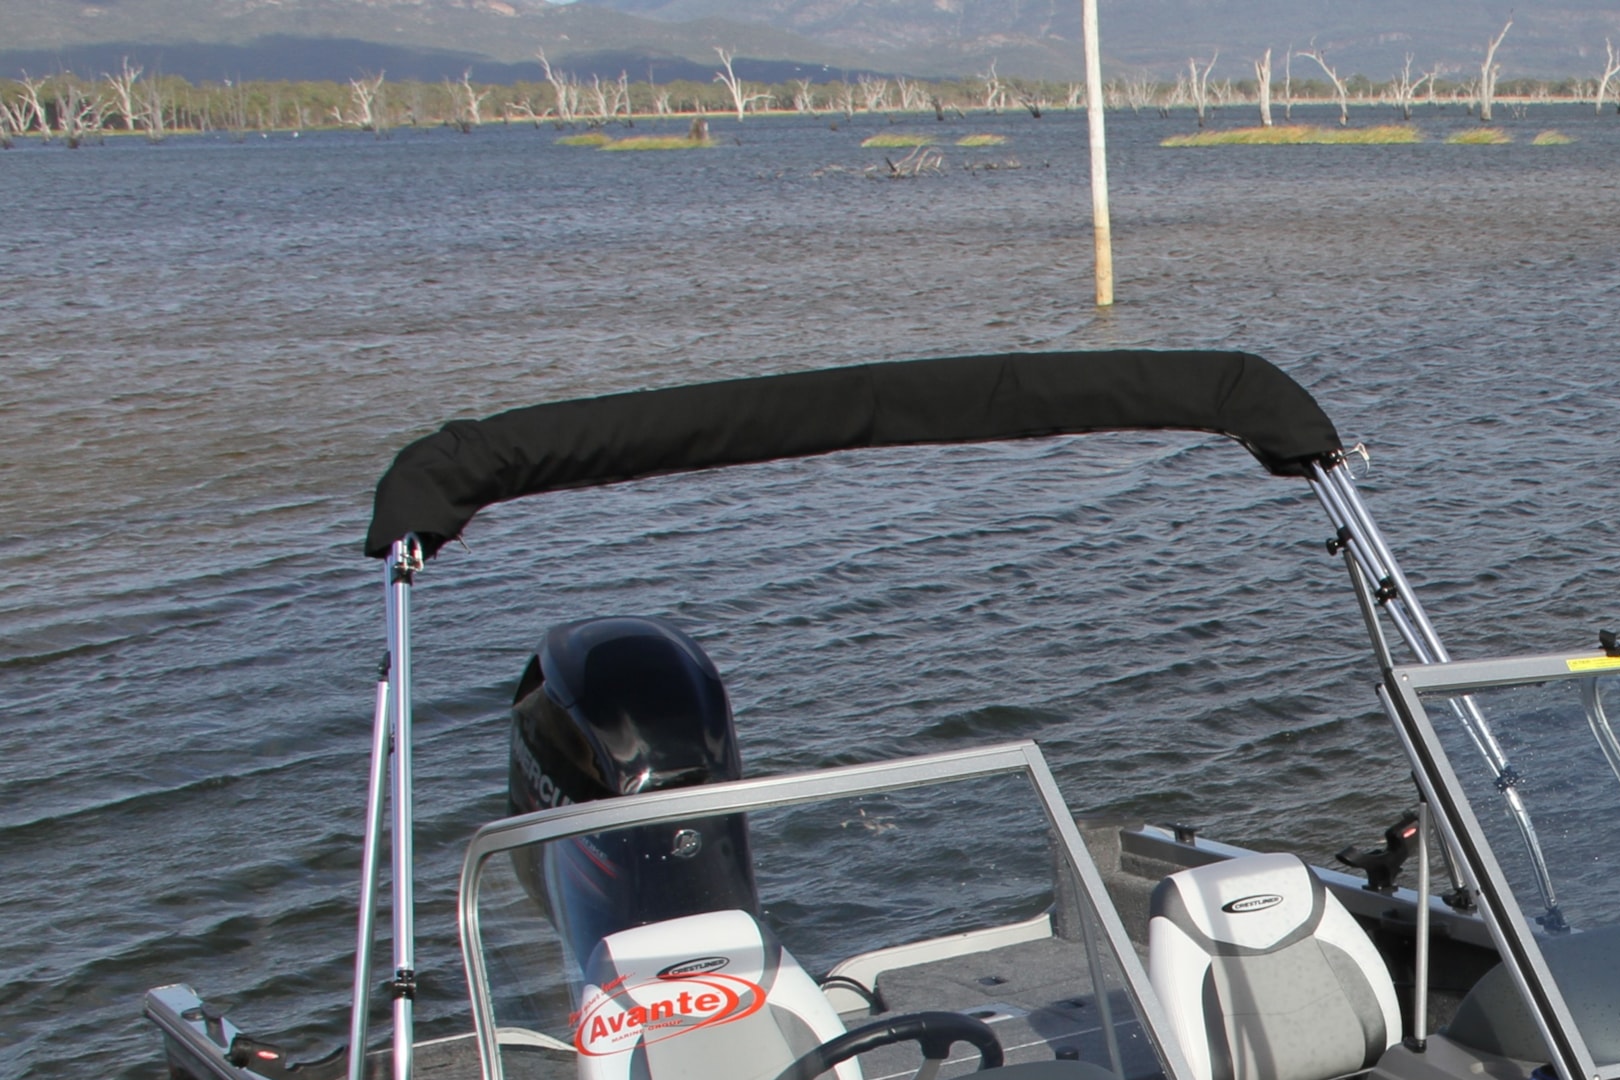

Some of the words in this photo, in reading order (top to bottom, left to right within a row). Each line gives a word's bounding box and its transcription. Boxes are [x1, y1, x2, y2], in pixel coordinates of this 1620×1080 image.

[512, 723, 577, 808] MERCU
[589, 991, 721, 1045] Avante
[648, 1019, 684, 1031] GROUP
